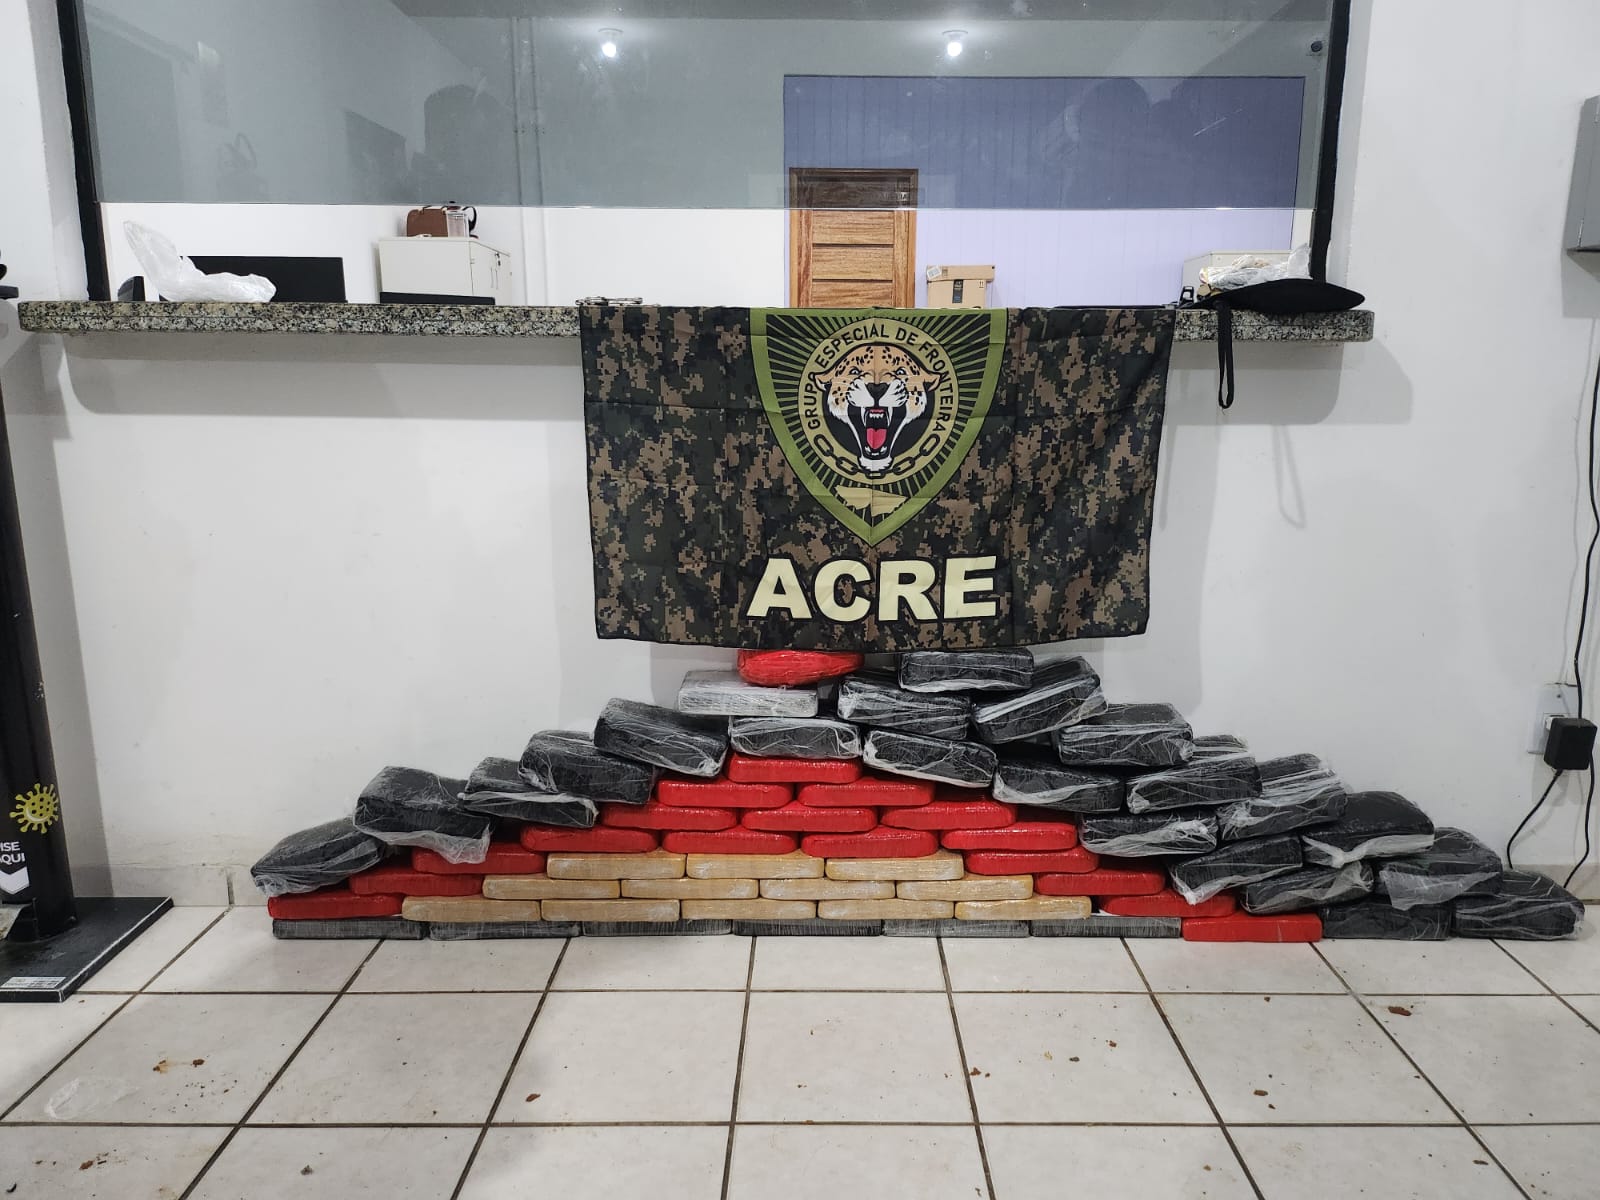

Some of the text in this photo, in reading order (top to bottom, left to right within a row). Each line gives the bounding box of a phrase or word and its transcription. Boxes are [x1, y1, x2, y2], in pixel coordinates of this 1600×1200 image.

[815, 323, 890, 369] ESPECIAL
[895, 327, 919, 346] DE
[918, 341, 954, 432] FRONTEIRA
[746, 555, 997, 622] ACRE
[0, 852, 26, 865] QUI
